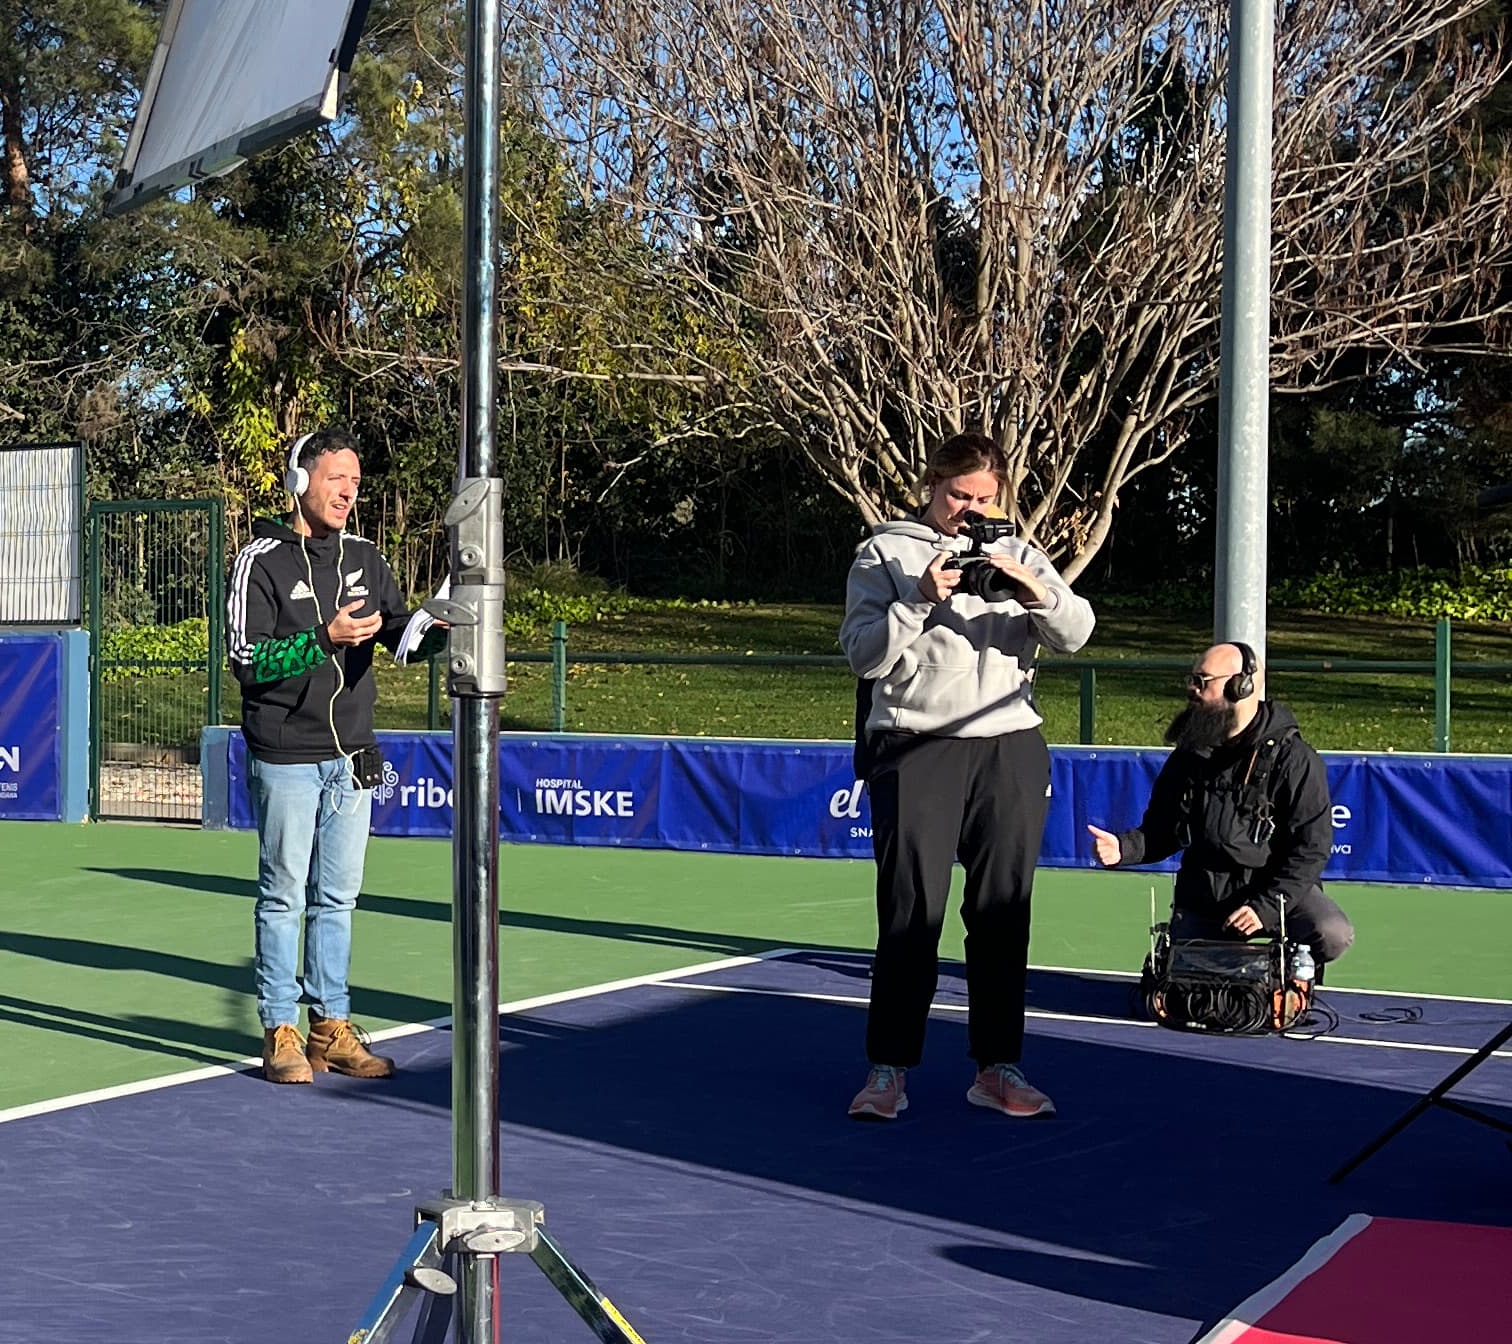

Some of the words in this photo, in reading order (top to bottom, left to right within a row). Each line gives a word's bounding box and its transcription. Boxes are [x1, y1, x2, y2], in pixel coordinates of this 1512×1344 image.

[536, 778, 583, 789] HOSPITAL
[536, 789, 634, 816] IMSKE
[829, 779, 865, 818] el
